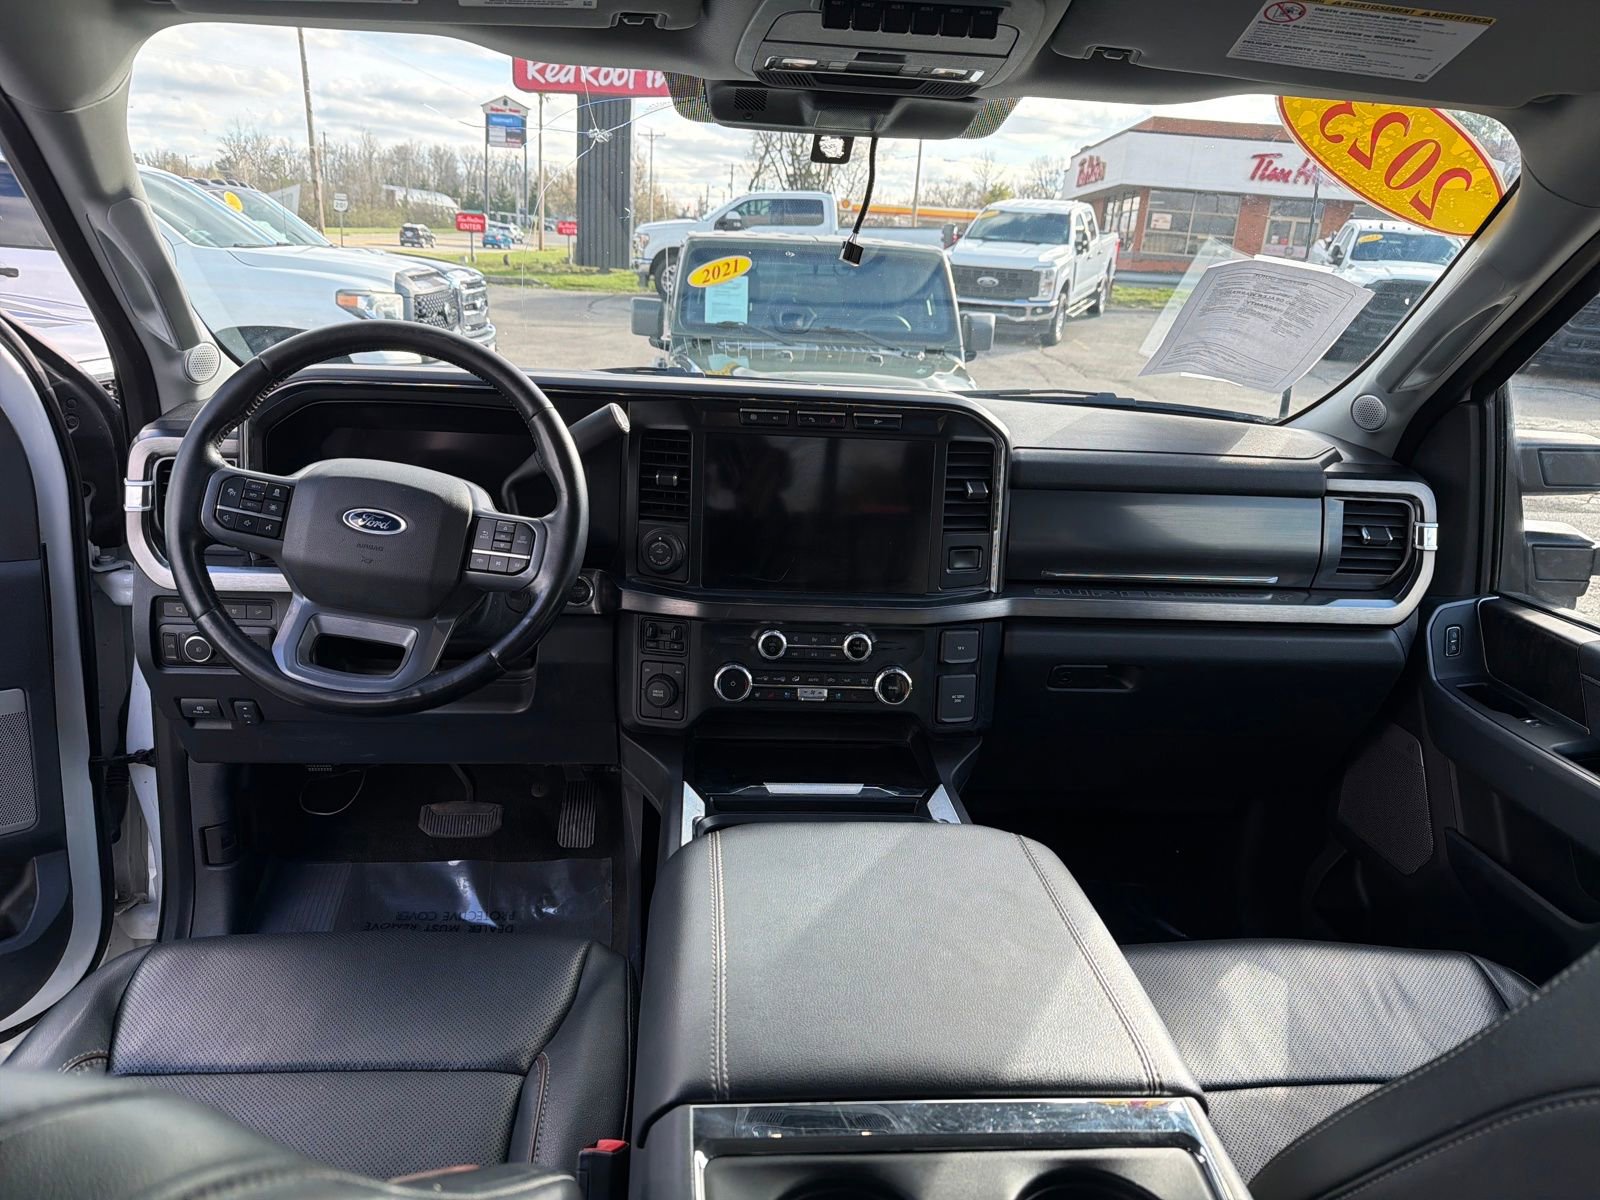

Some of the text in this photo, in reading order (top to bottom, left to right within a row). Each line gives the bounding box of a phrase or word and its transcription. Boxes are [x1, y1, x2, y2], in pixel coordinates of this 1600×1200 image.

[1432, 11, 1494, 25] ADVERTENCIA
[459, 222, 482, 231] ENTER
[702, 259, 739, 284] 2021
[357, 512, 392, 530] Ford
[443, 911, 515, 921] PROTECTIVE
[362, 921, 514, 934] DEALER MUST REMOVE
